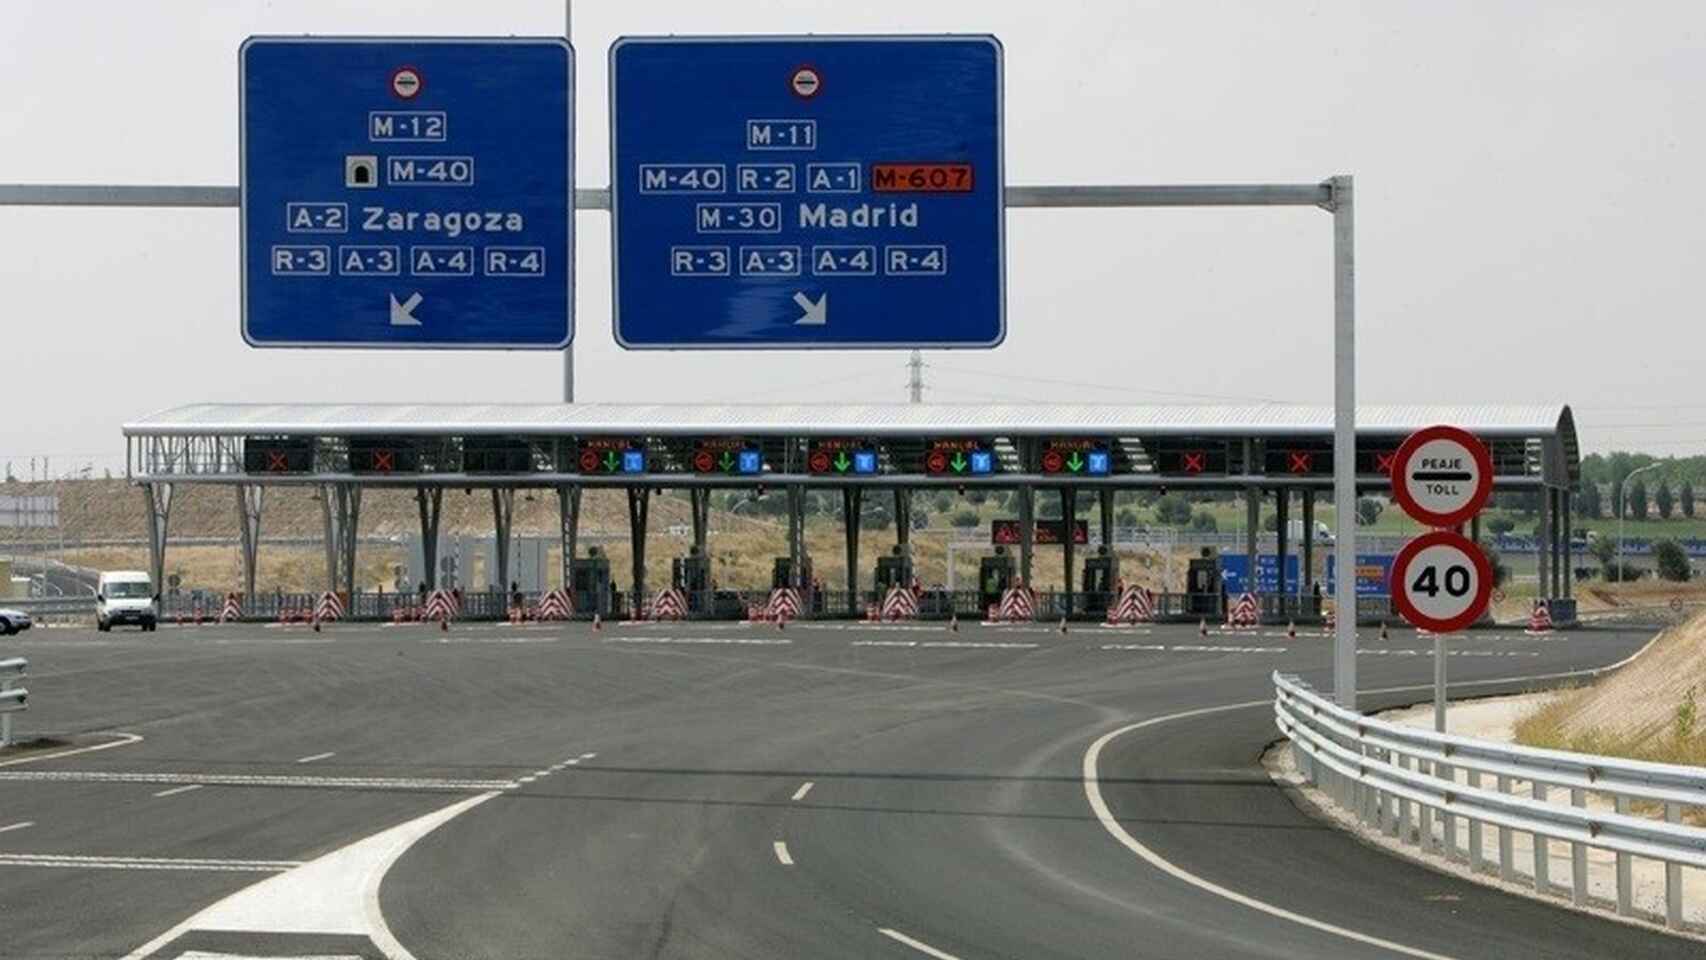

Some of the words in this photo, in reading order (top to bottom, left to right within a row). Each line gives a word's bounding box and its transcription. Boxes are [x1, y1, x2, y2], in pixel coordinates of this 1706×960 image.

[373, 117, 442, 137] M-12
[751, 124, 812, 145] M-11
[393, 161, 468, 181] M-40
[644, 168, 721, 188] M-40
[740, 168, 791, 188] R-2
[812, 168, 858, 188] A-1
[874, 167, 968, 187] M-607
[294, 208, 342, 228] A-2
[362, 206, 524, 237] Zaragoza
[701, 208, 777, 228] M-30
[799, 203, 918, 229] Madrid
[275, 250, 326, 270] R-3
[345, 250, 394, 270] A-3
[416, 251, 467, 271] A-4
[488, 251, 540, 271] R-4
[675, 251, 726, 271] R-3
[745, 251, 796, 271] A-3
[817, 251, 870, 271] A-4
[890, 251, 941, 271] R-4
[1421, 457, 1463, 470] PEAJE
[1425, 483, 1459, 496] TOLL
[1411, 565, 1471, 598] 40
